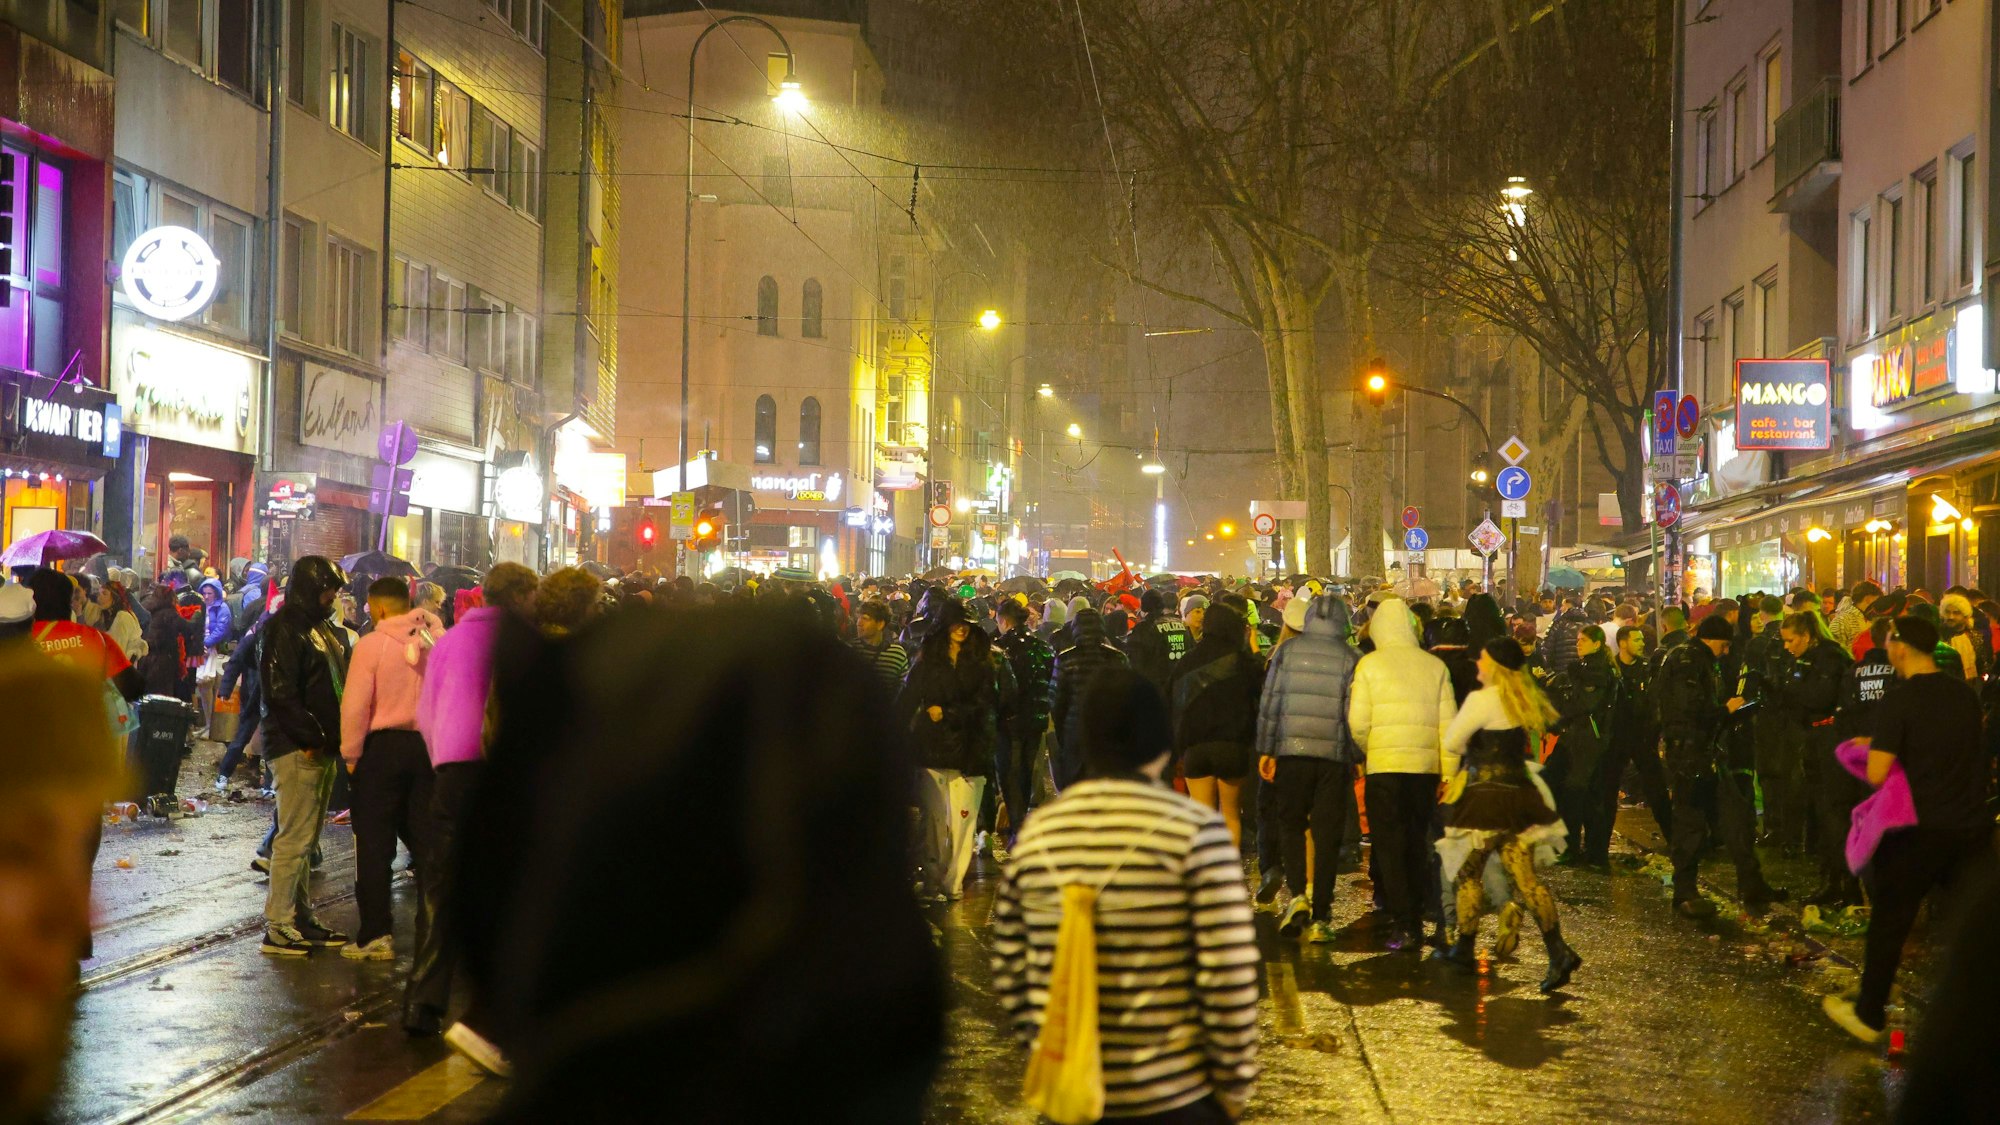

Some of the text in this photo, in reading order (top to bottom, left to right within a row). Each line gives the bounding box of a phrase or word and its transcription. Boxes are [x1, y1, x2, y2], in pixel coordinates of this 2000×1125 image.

[1741, 382, 1827, 406] MANGO
[26, 397, 103, 442] KWARTIER
[1751, 416, 1816, 428] cafe bar
[1750, 429, 1816, 439] restaurant
[1655, 439, 1673, 453] TAXI
[1157, 621, 1186, 633] POLIZE
[1168, 634, 1184, 643] NRW
[1860, 679, 1884, 691] NRW
